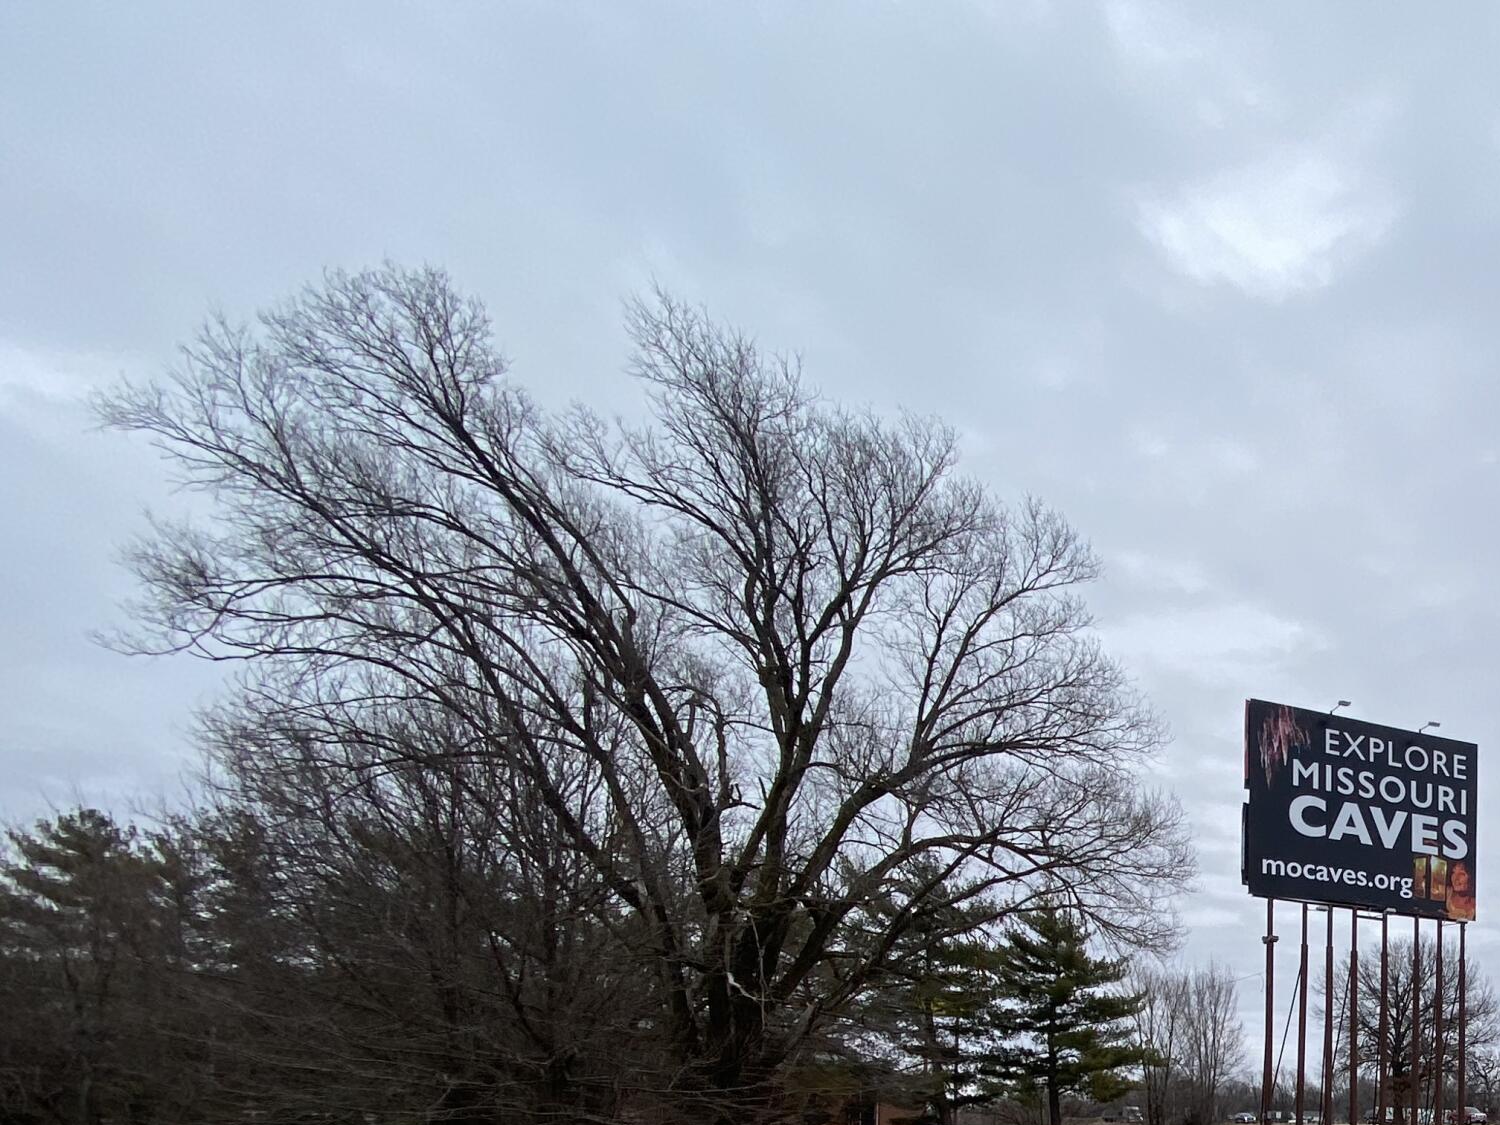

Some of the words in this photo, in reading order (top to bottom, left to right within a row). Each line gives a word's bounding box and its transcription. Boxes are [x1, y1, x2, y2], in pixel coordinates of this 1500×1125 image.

[1324, 728, 1468, 780] EXPLORE
[1292, 758, 1468, 816] MISSOURI
[1288, 795, 1468, 860] CAVES
[1261, 858, 1414, 899] mocaves.org
